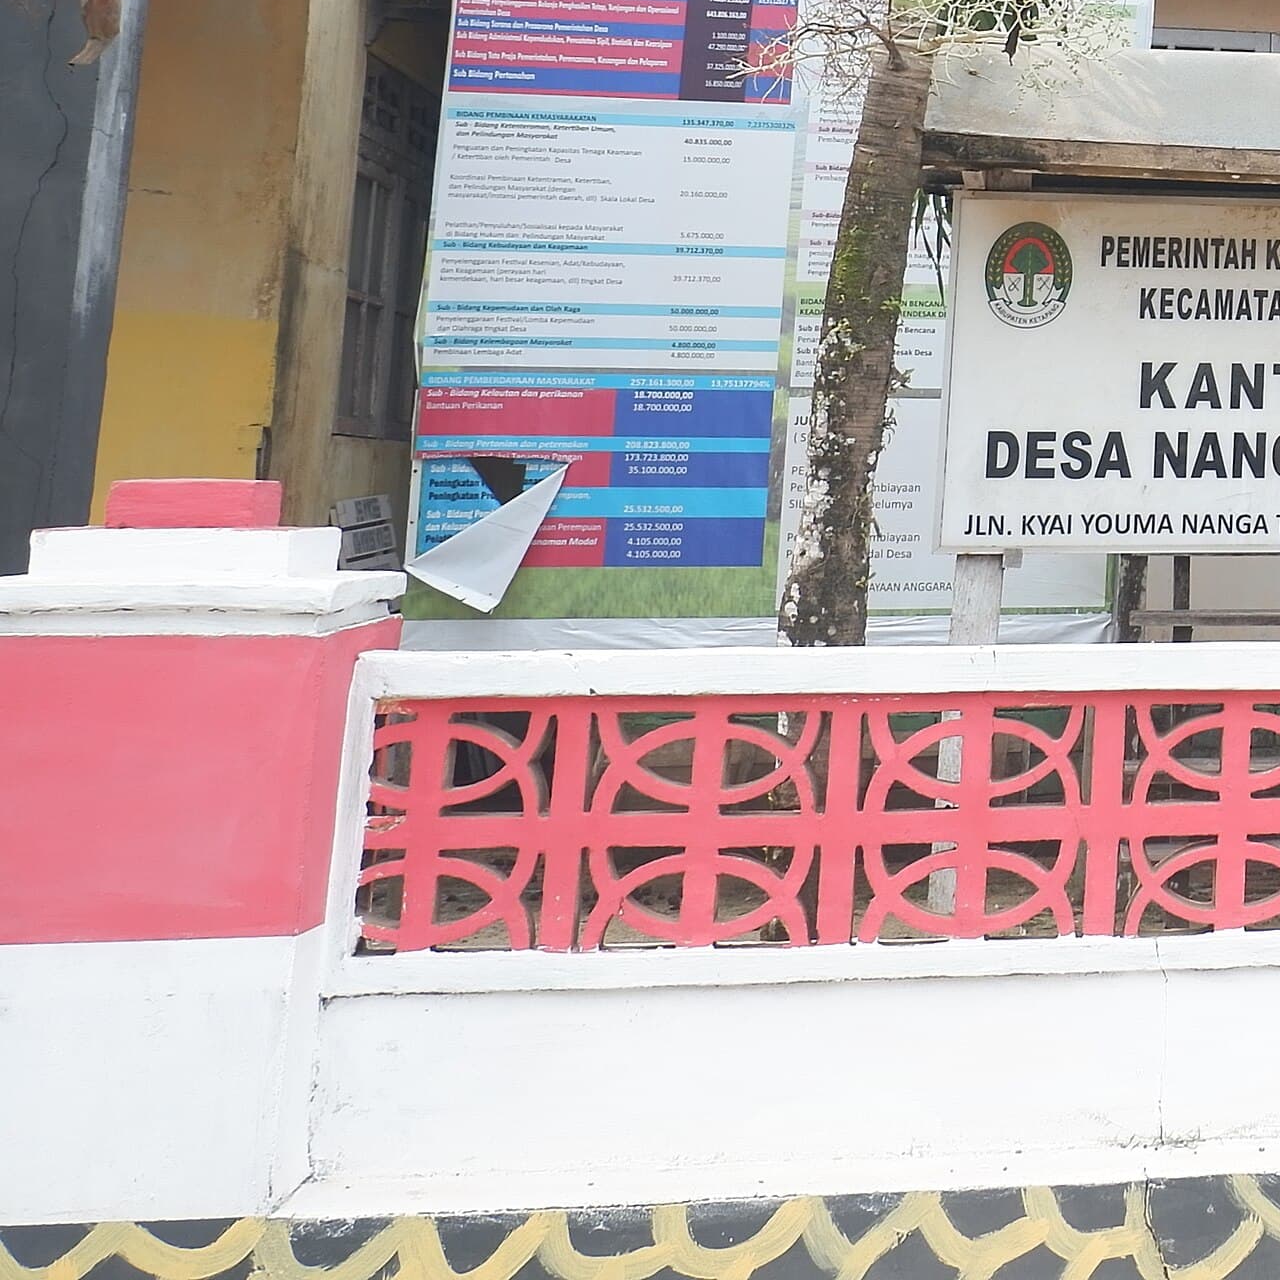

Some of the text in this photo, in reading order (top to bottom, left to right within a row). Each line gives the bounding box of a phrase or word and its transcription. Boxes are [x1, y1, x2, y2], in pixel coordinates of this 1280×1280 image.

[1101, 235, 1256, 271] PEMERINTAH
[995, 302, 1059, 324] KABUPATEN KETAPANG
[427, 389, 443, 398] Sub
[516, 390, 535, 398] dan
[985, 431, 1132, 480] DESA
[872, 482, 921, 494] mbiayaan
[964, 514, 1013, 537] JLN.
[1021, 514, 1073, 536] KYAI
[1081, 514, 1171, 536] YOUMA
[1182, 513, 1268, 535] NANGA
[887, 549, 912, 559] Desa
[903, 582, 952, 592] ANGGARA
